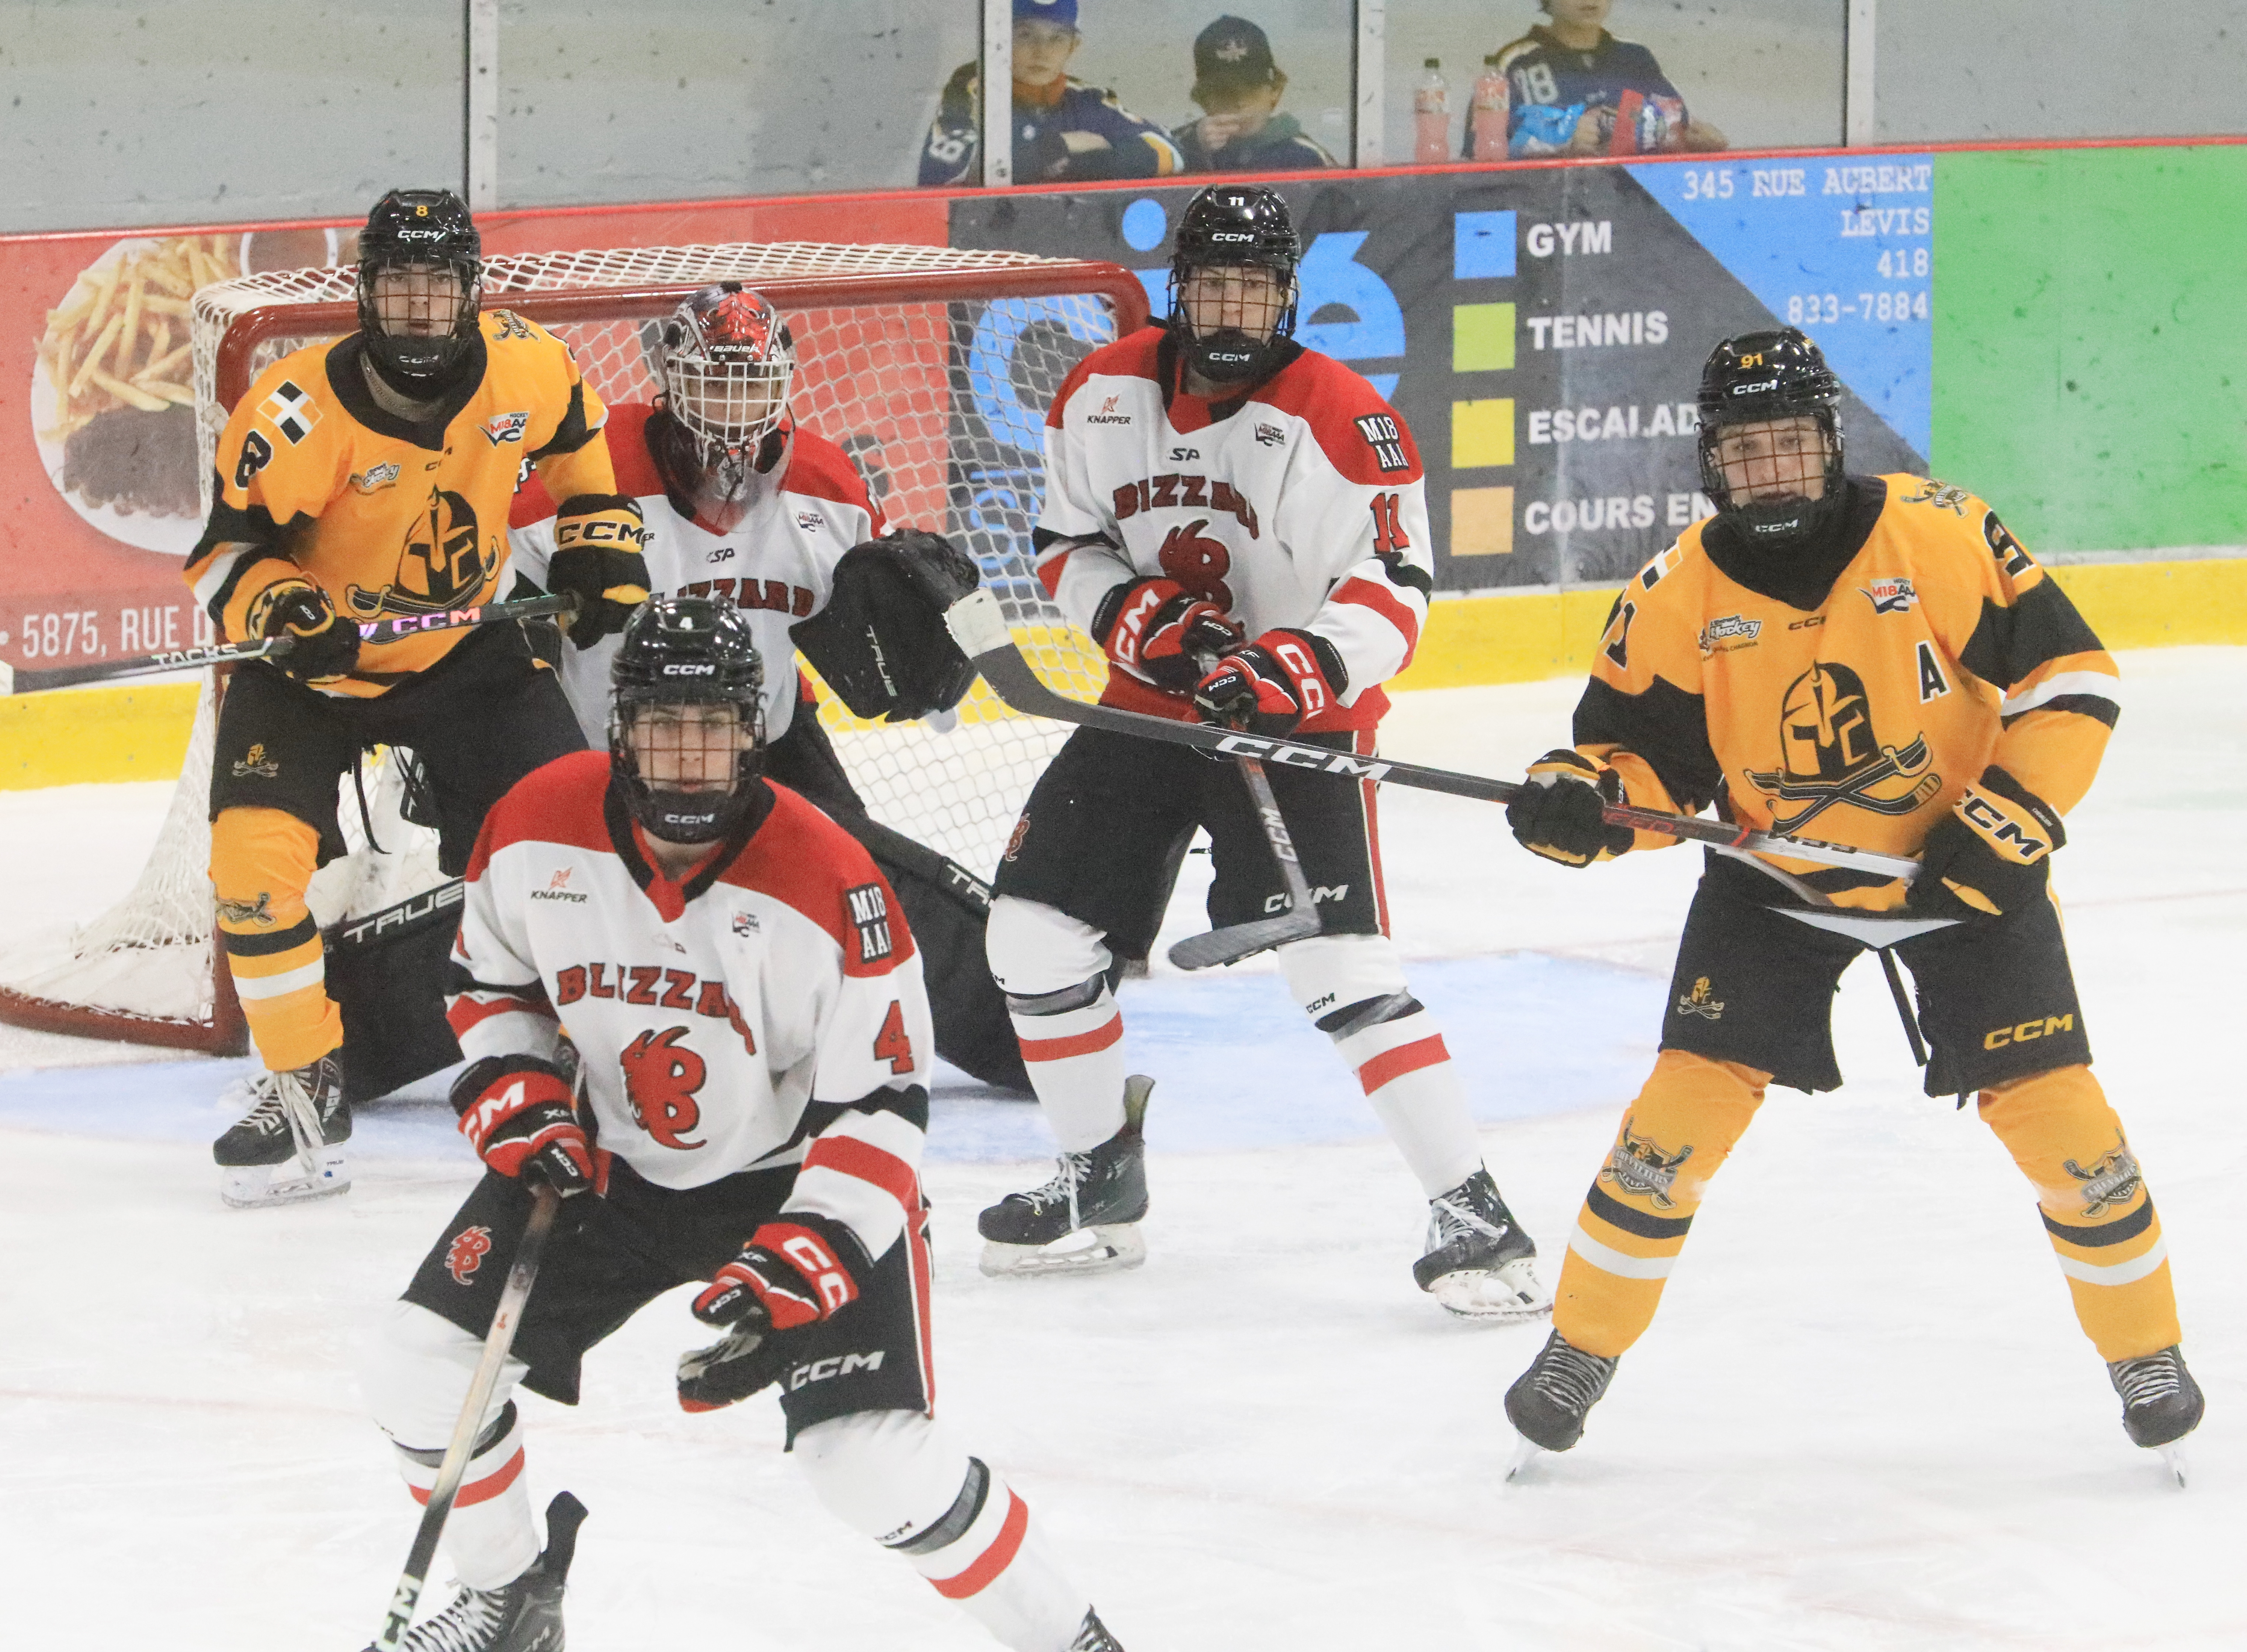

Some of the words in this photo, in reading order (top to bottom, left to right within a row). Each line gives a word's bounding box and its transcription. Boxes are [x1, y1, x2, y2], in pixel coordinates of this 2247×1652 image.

[1683, 170, 1733, 200] 345
[1753, 169, 1805, 197] RUE
[1822, 165, 1931, 195] AUBERT
[416, 205, 428, 217] 8
[1228, 197, 1244, 206] 11
[397, 230, 439, 239] CCM
[1841, 208, 1929, 236] LEVIS
[1212, 233, 1254, 242] CCM
[1527, 221, 1612, 257] GYM
[1877, 248, 1928, 278] 418
[1788, 292, 1928, 324] 833-7884
[1527, 310, 1669, 350] TENNIS
[1209, 353, 1250, 361] CCM
[1741, 354, 1763, 368] 91
[1733, 380, 1778, 395] CCM
[490, 419, 526, 434] M18AA
[1087, 415, 1131, 424] KNAPPER
[1358, 416, 1398, 442] M18
[1529, 403, 1701, 444] ESCALAD
[1376, 443, 1409, 468] AAA
[1370, 493, 1410, 553] 11
[1525, 493, 1655, 534] COURS
[1667, 492, 1719, 526] EN
[1756, 519, 1798, 532] CCM
[558, 521, 645, 545] CCM
[22, 611, 107, 658] 5875,
[121, 606, 179, 651] RUE
[194, 605, 210, 646] D
[392, 607, 480, 634] CCM
[679, 617, 693, 631] 4
[1116, 589, 1161, 663] CM
[664, 664, 715, 675] CCM
[867, 625, 898, 697] TRUE
[1916, 640, 1951, 704] A
[1209, 676, 1237, 692] CCM
[1276, 643, 1325, 719] CC
[1216, 736, 1392, 780] CCM
[665, 813, 714, 824] CCM
[1259, 807, 1297, 862] CCM
[530, 889, 587, 903] KNAPPER
[947, 864, 995, 907] TR
[1265, 885, 1349, 913] CM
[342, 882, 464, 943] TRUE
[850, 886, 886, 923] M18
[556, 962, 756, 1055] BLIZZA
[1306, 992, 1335, 1014] CCM
[874, 999, 914, 1075] 4
[1983, 1013, 2074, 1051] CCM
[551, 1148, 578, 1177] CCM
[783, 1236, 849, 1316] CC
[791, 1351, 885, 1391] CCM
